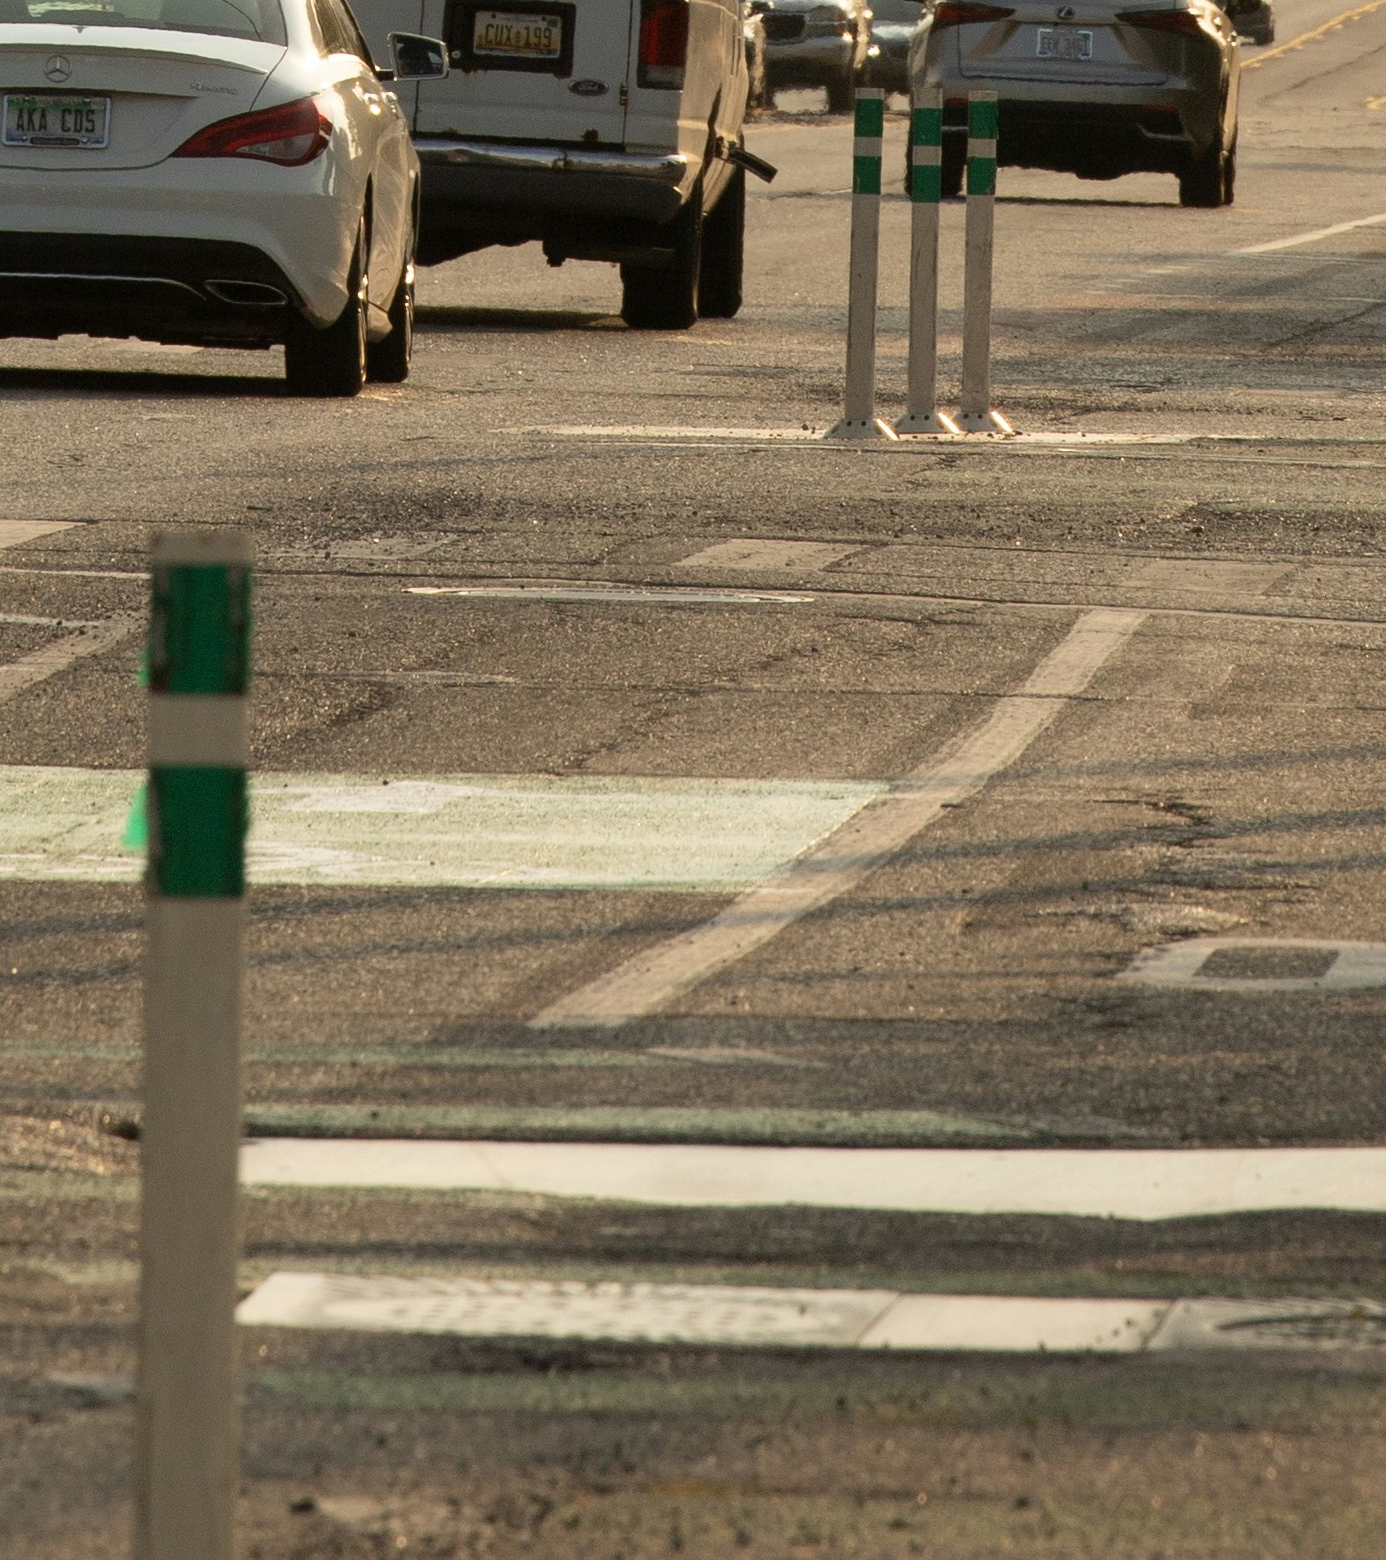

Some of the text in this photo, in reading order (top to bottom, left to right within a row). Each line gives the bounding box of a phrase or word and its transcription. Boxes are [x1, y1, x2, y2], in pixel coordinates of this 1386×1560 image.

[484, 23, 553, 48] CUX 199
[16, 107, 48, 132] AKA
